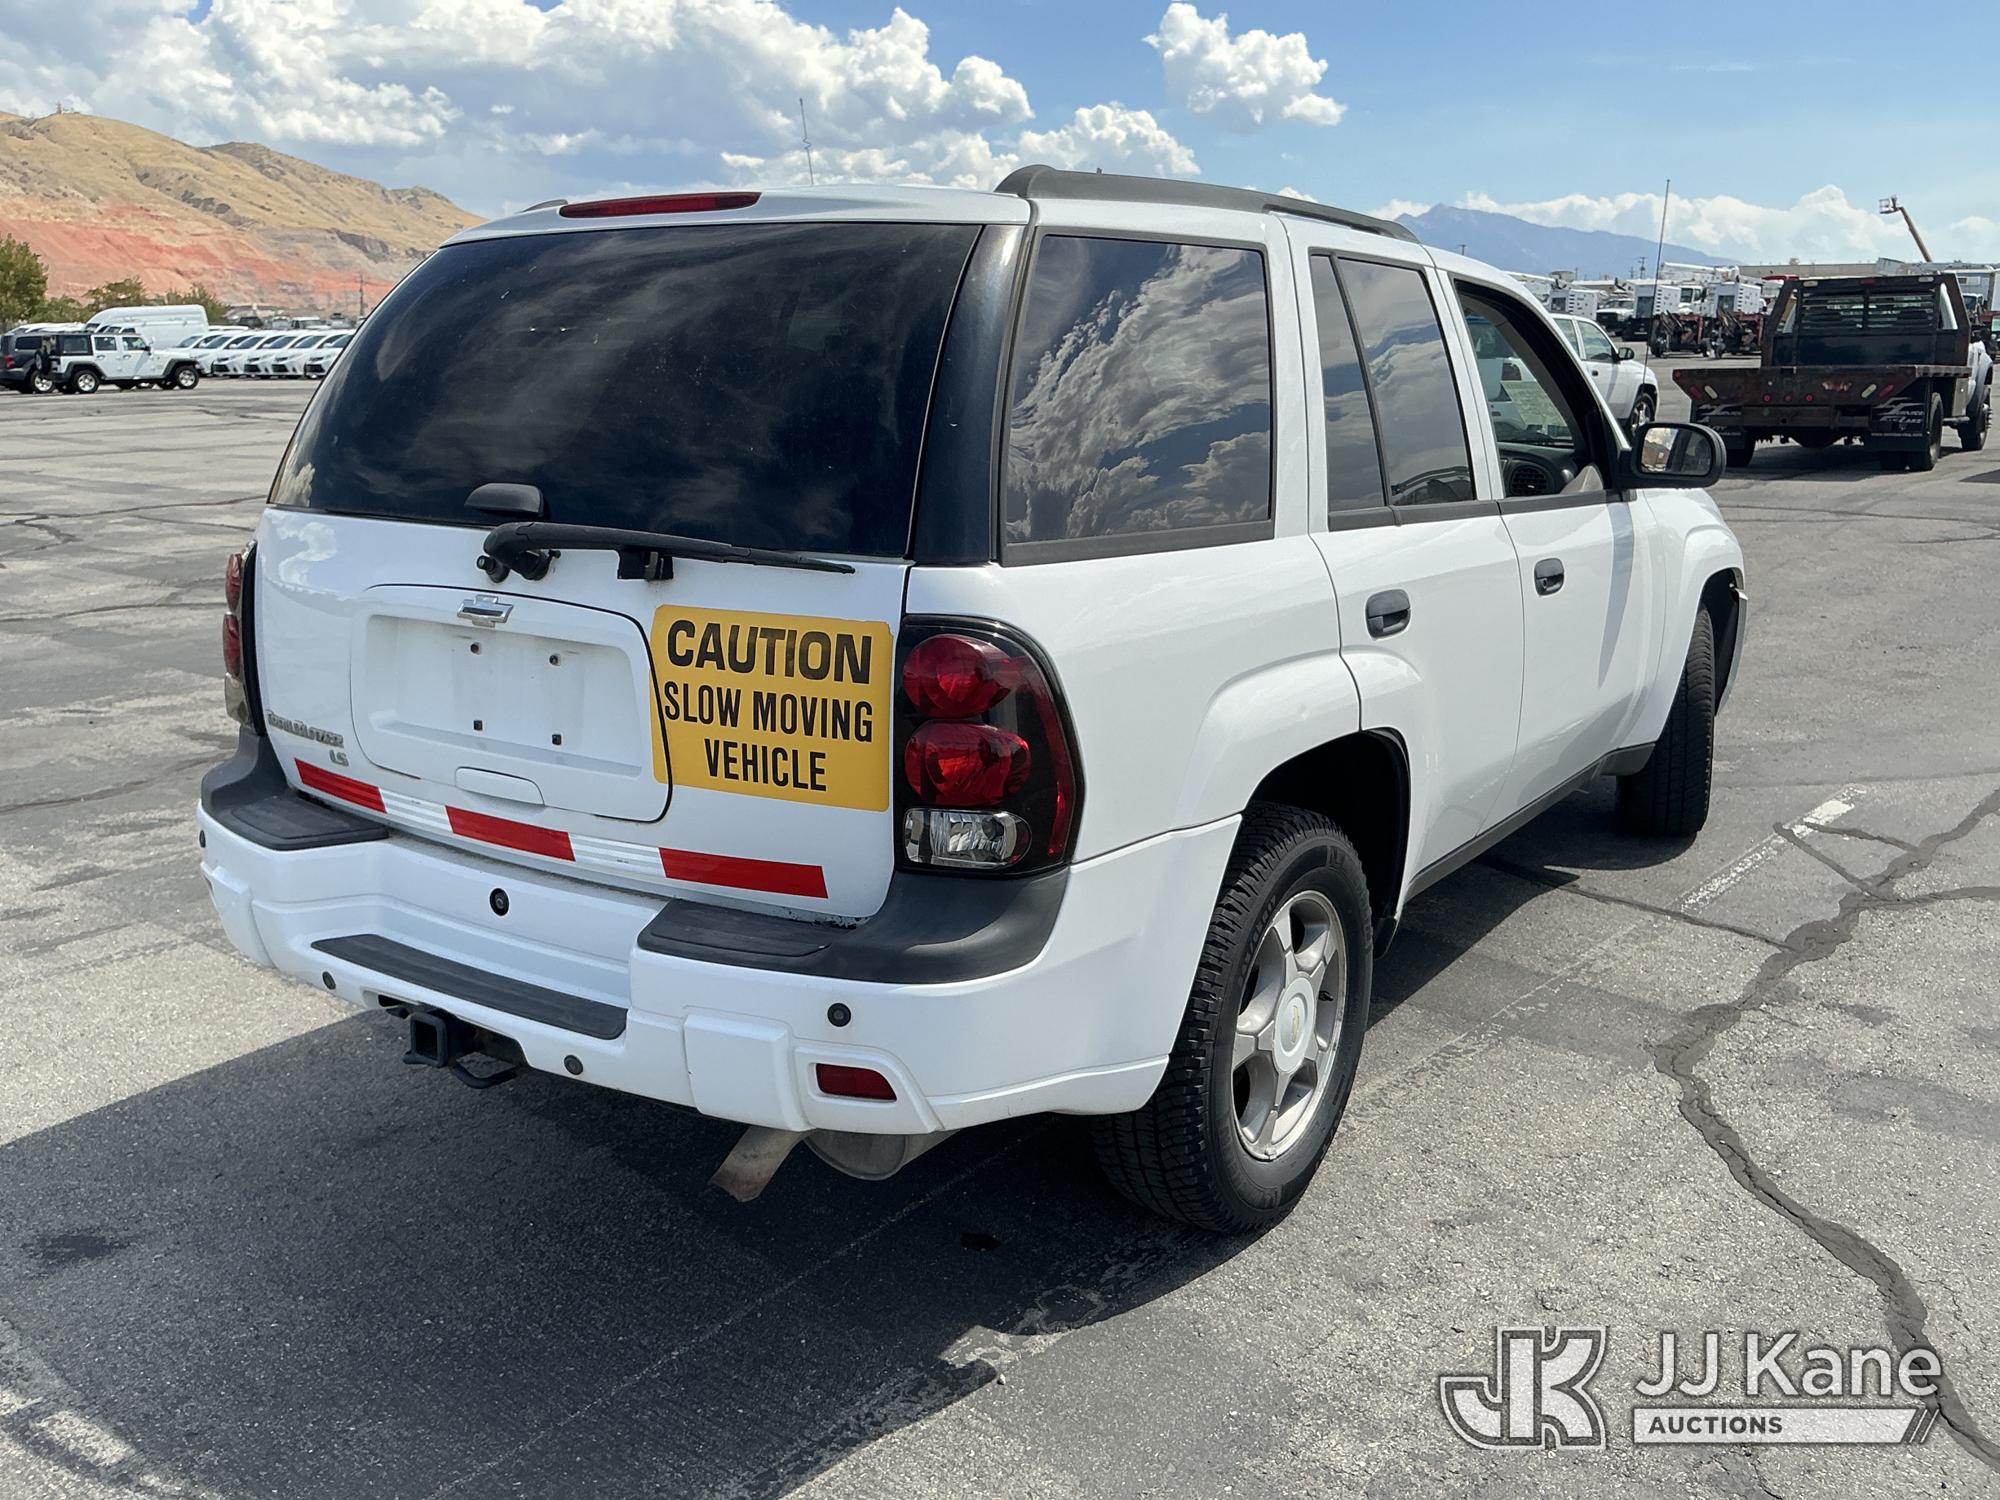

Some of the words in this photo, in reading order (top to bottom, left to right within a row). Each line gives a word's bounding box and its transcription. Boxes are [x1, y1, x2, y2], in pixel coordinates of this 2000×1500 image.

[667, 619, 872, 685] CAUTION
[664, 680, 742, 728] SLOW
[753, 690, 873, 743] MOVING
[329, 749, 349, 767] LS
[704, 738, 827, 792] VEHICLE
